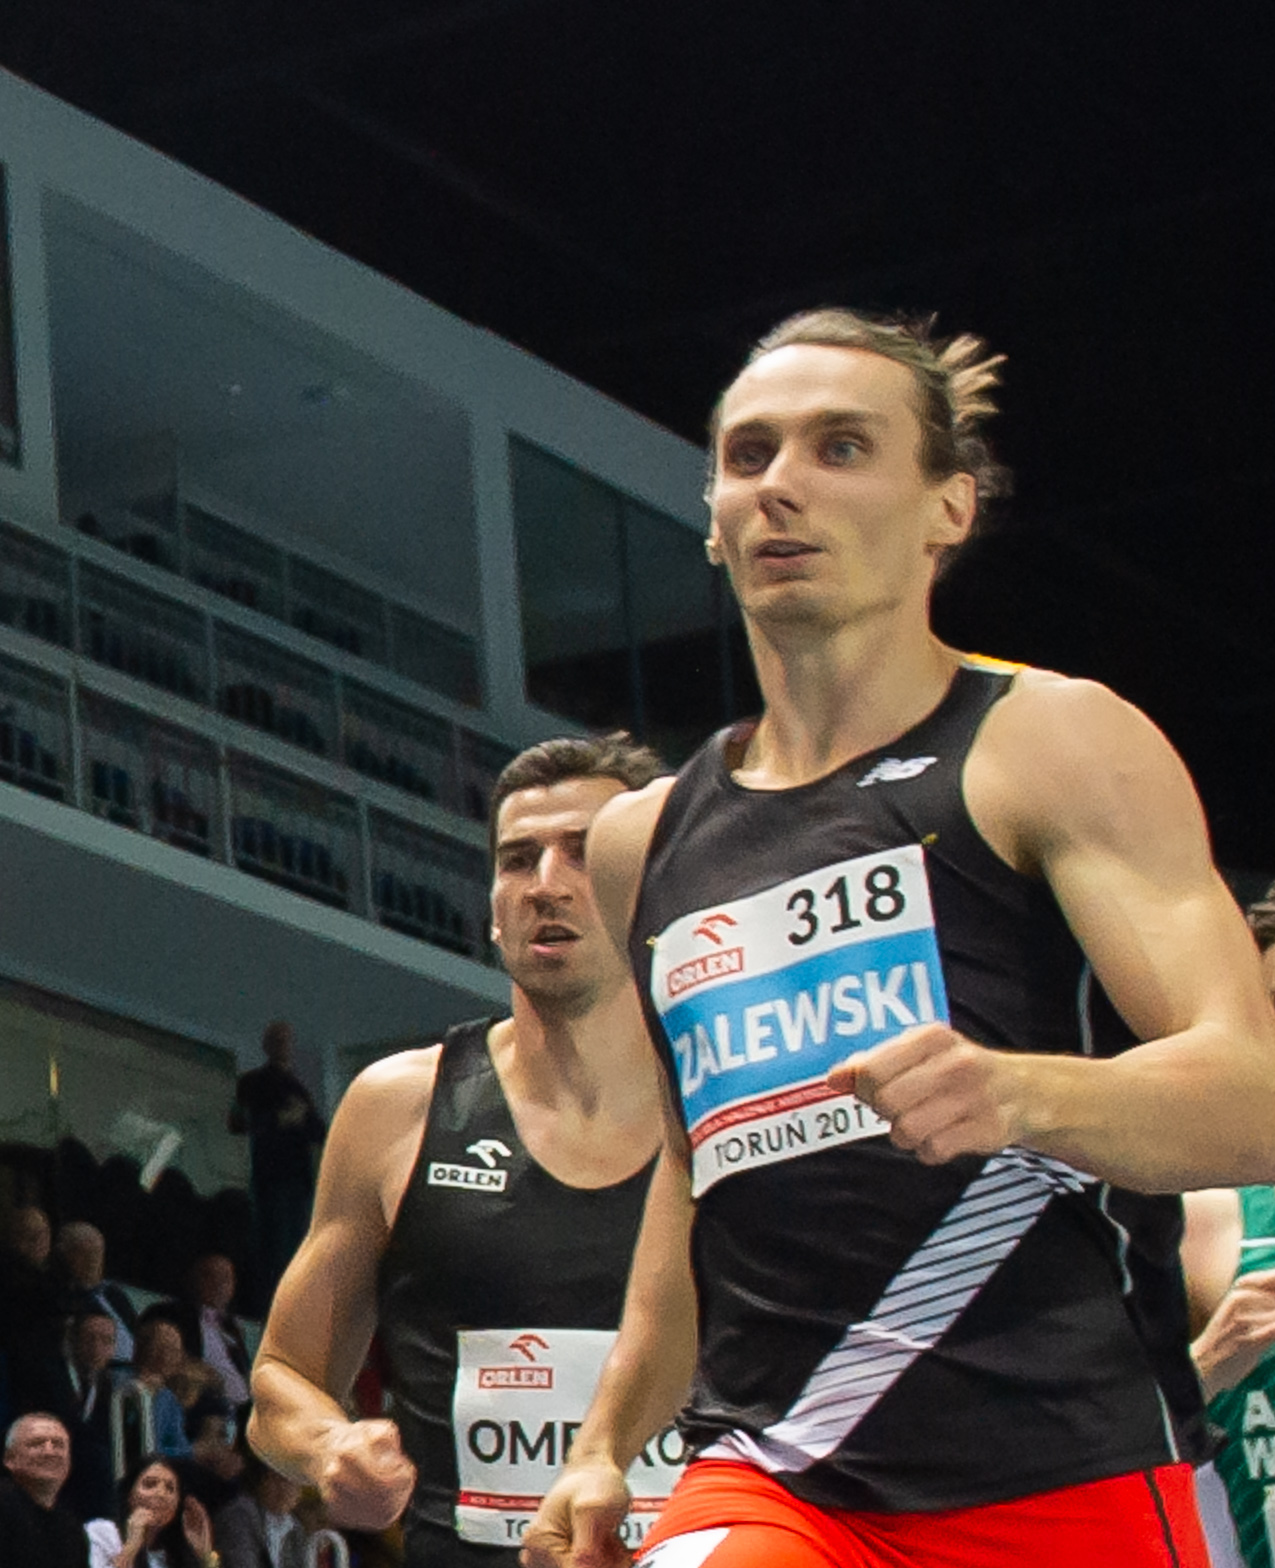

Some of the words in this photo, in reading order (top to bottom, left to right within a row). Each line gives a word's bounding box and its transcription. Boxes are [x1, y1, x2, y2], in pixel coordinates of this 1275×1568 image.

[786, 864, 906, 947] 318
[674, 961, 935, 1097] ZALEWSKI
[433, 1167, 502, 1187] ORLEN
[481, 1369, 549, 1387] ORLEN
